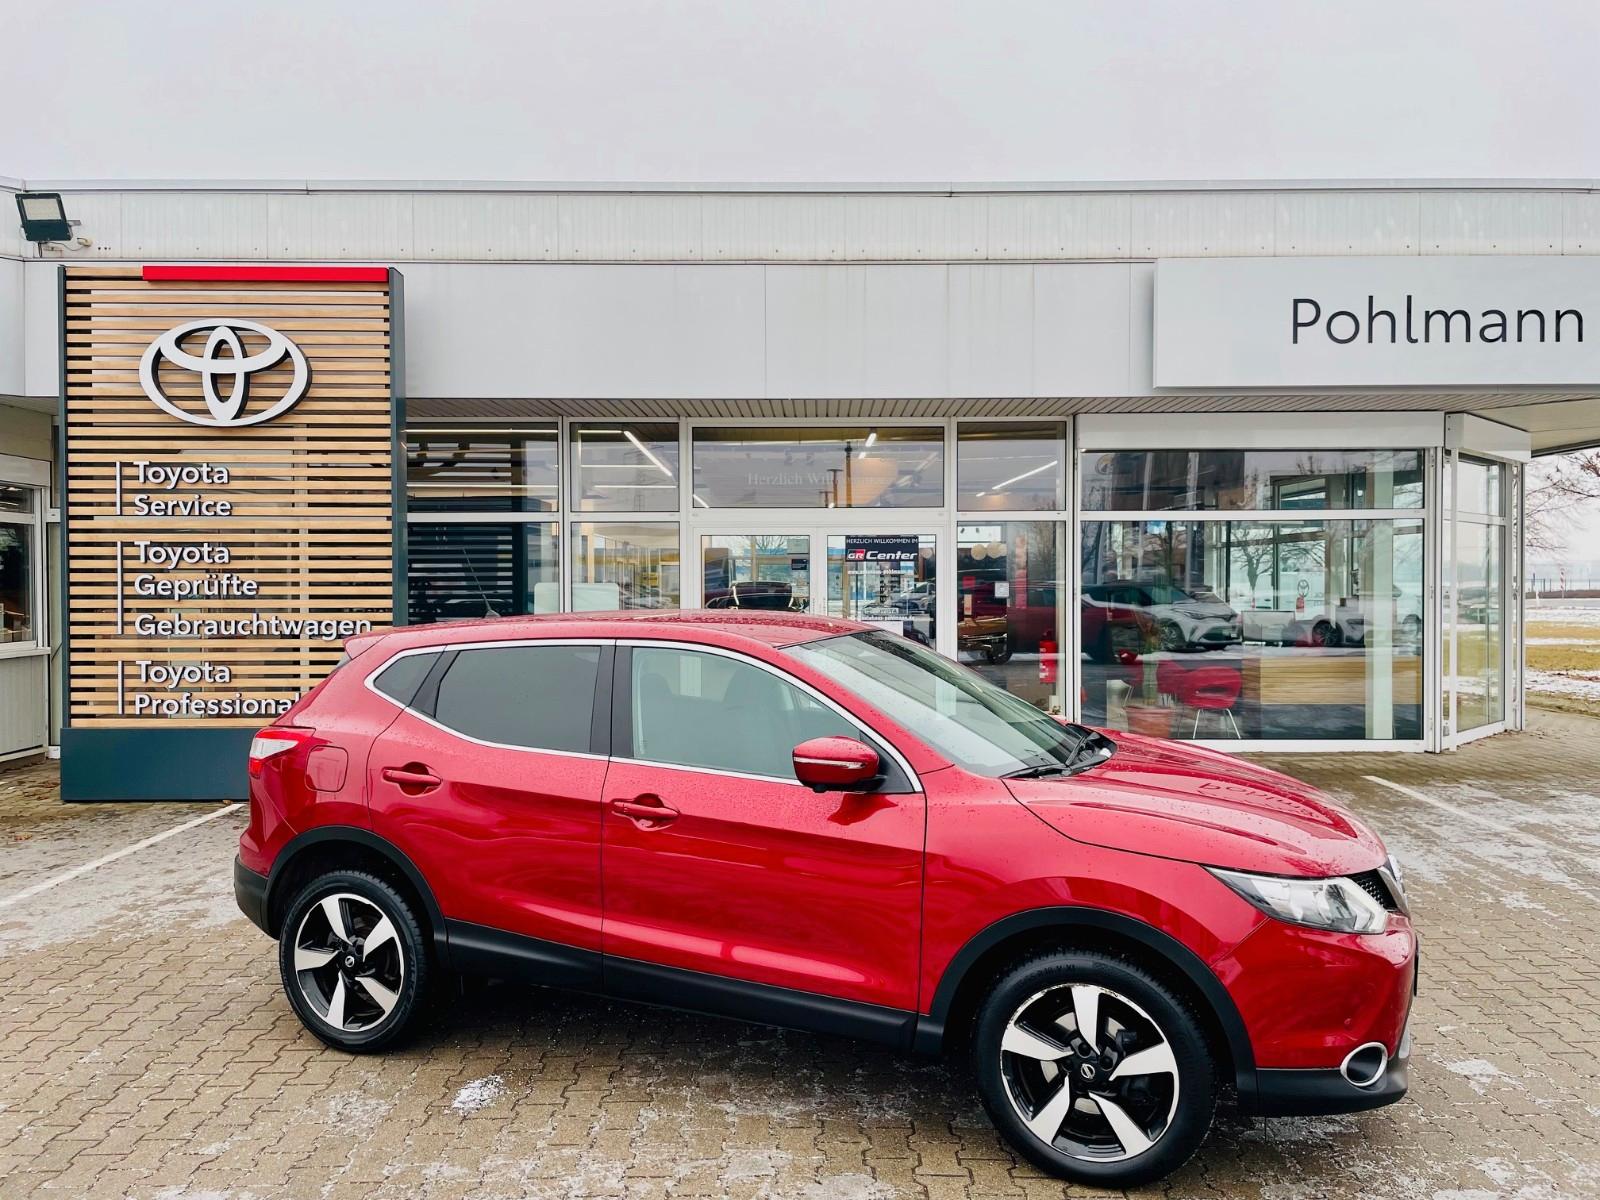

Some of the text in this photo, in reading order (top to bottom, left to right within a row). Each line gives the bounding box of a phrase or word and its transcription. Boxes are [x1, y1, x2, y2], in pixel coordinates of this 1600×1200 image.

[1292, 294, 1584, 345] Pohlmann
[134, 461, 229, 489] Toyota
[134, 493, 231, 516] Service
[134, 541, 230, 568] Toyota
[847, 550, 918, 560] GR Center
[134, 573, 258, 601] Geprüfte
[134, 612, 371, 641] Gebrauchtwagen
[135, 660, 230, 687] Toyota
